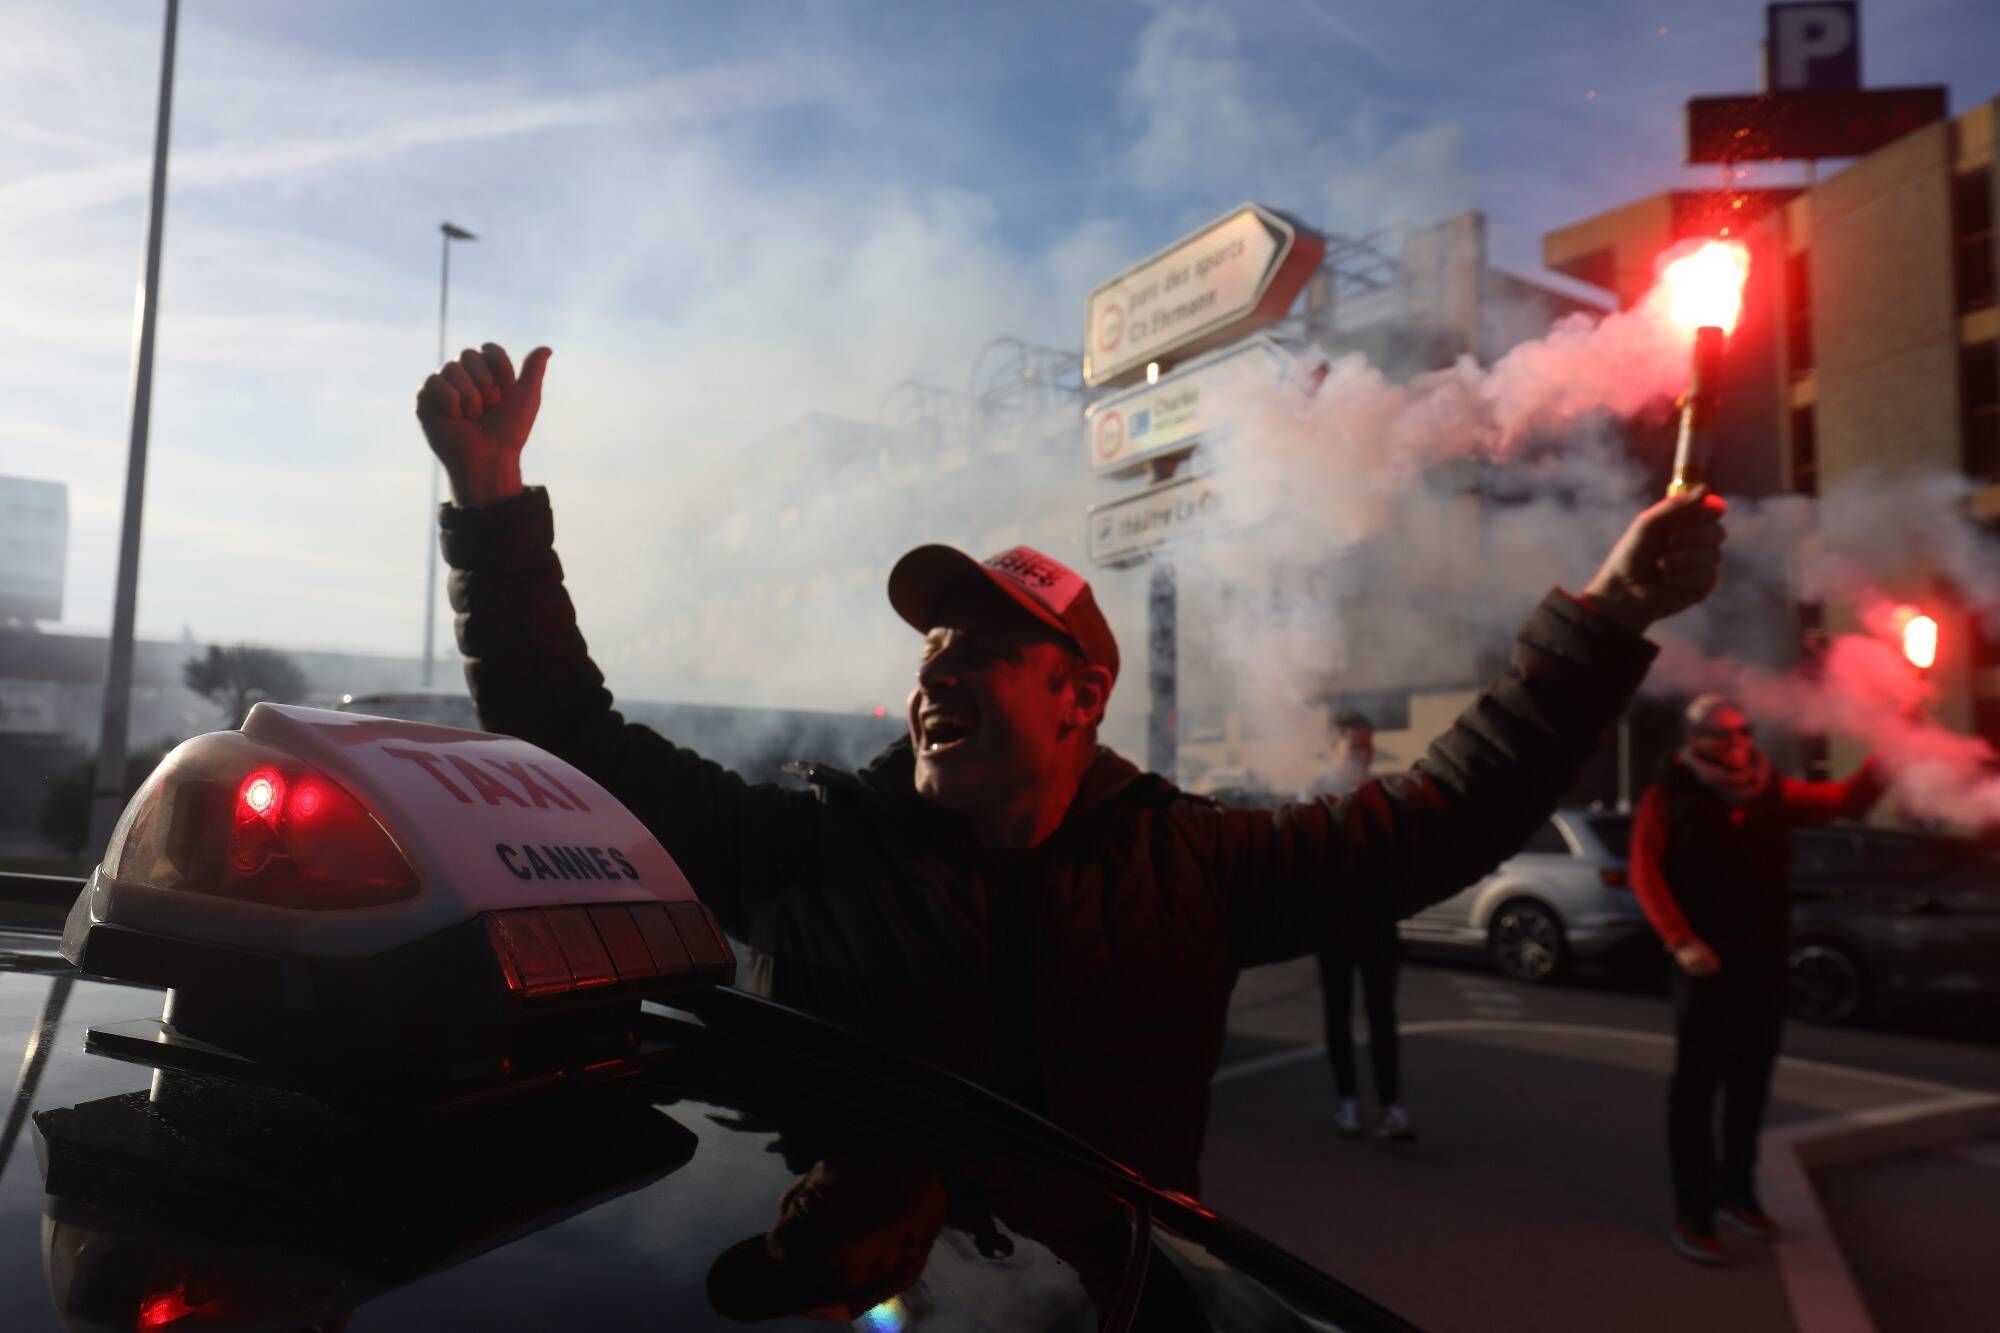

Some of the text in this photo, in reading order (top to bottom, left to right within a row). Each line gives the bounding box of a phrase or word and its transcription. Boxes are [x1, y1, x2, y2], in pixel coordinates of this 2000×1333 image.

[1777, 6, 1850, 88] P
[379, 746, 592, 813] TAXI
[495, 842, 640, 881] CANNES
